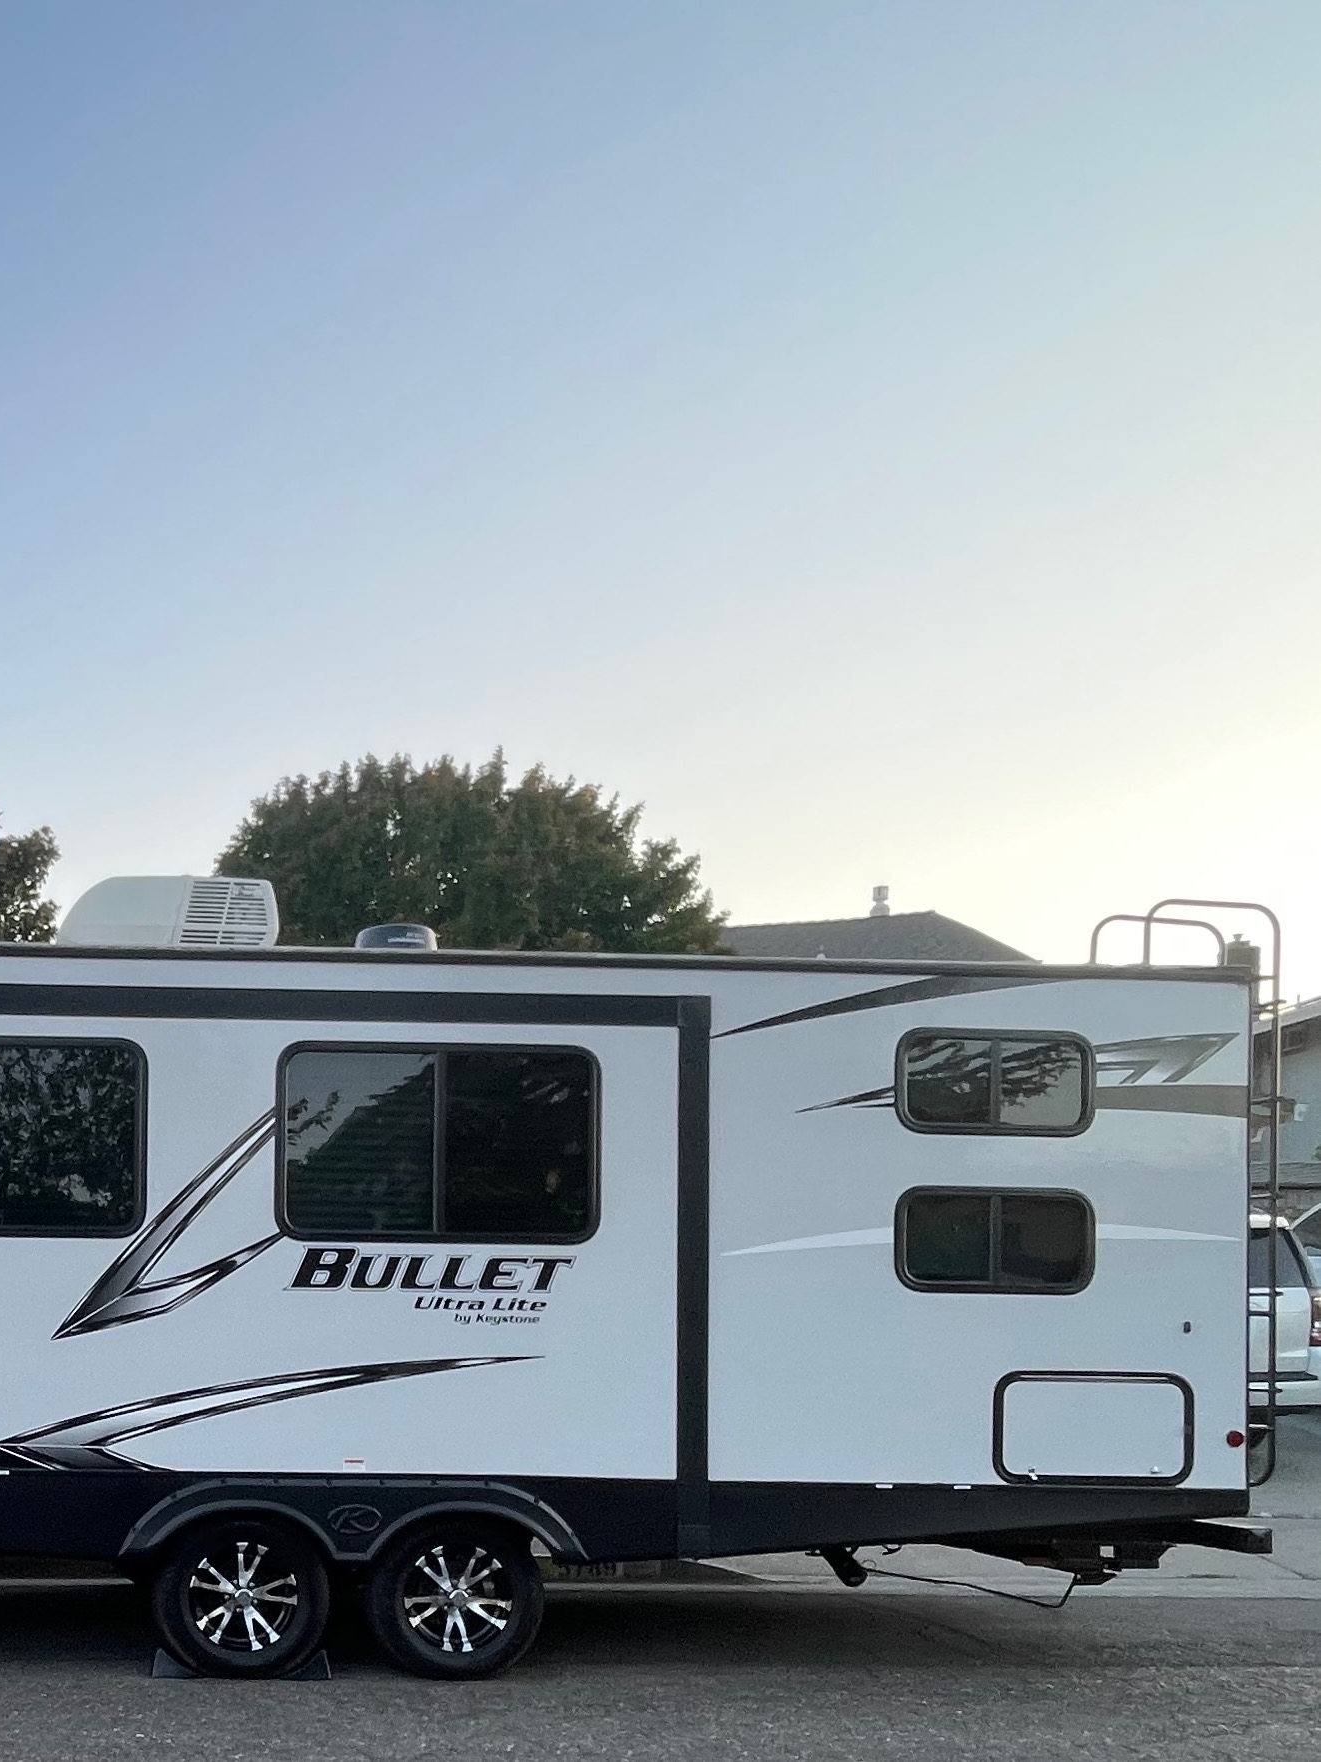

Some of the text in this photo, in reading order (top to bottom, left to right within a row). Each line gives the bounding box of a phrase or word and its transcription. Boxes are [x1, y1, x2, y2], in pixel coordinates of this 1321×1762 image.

[414, 1296, 547, 1311] Ultra Lite
[454, 1313, 540, 1325] by Keystone
